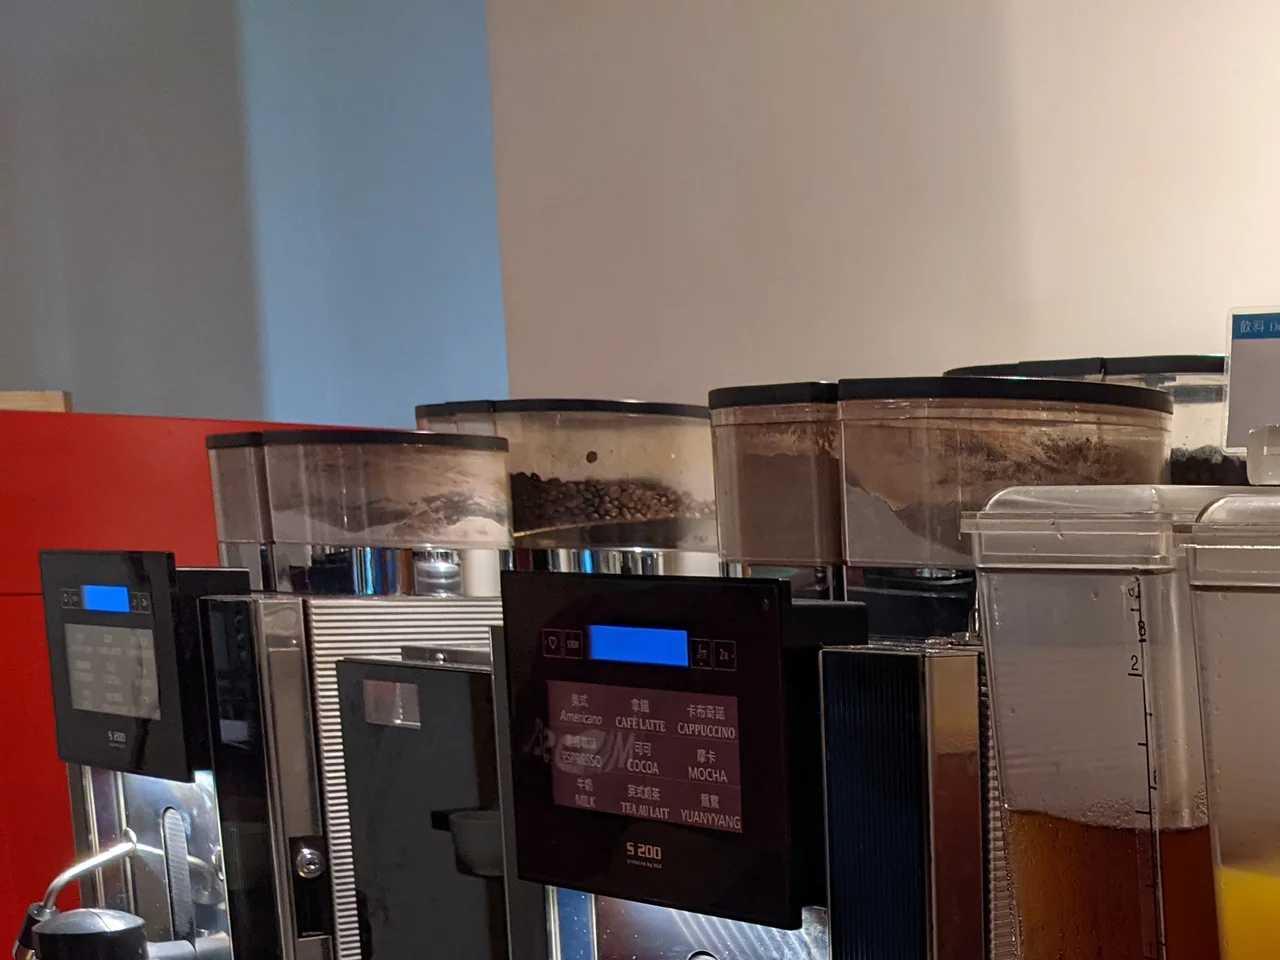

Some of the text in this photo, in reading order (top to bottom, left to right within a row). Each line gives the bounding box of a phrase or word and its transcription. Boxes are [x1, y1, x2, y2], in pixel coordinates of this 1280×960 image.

[1130, 655, 1139, 671] 2
[559, 710, 603, 725] Americano
[686, 704, 726, 721] 卡布奇諾
[615, 715, 666, 733] CAFÉ LATTE
[677, 722, 736, 740] CAPPUCCINO
[634, 741, 652, 757] 可可
[561, 751, 602, 769] ESPRESSO
[626, 758, 660, 776] COCOA
[687, 765, 728, 784] MOCHA
[575, 794, 596, 809] MILK
[621, 802, 670, 820] TEA AU LAIT
[680, 808, 742, 830] YUANYYANG
[626, 841, 662, 860] S 200
